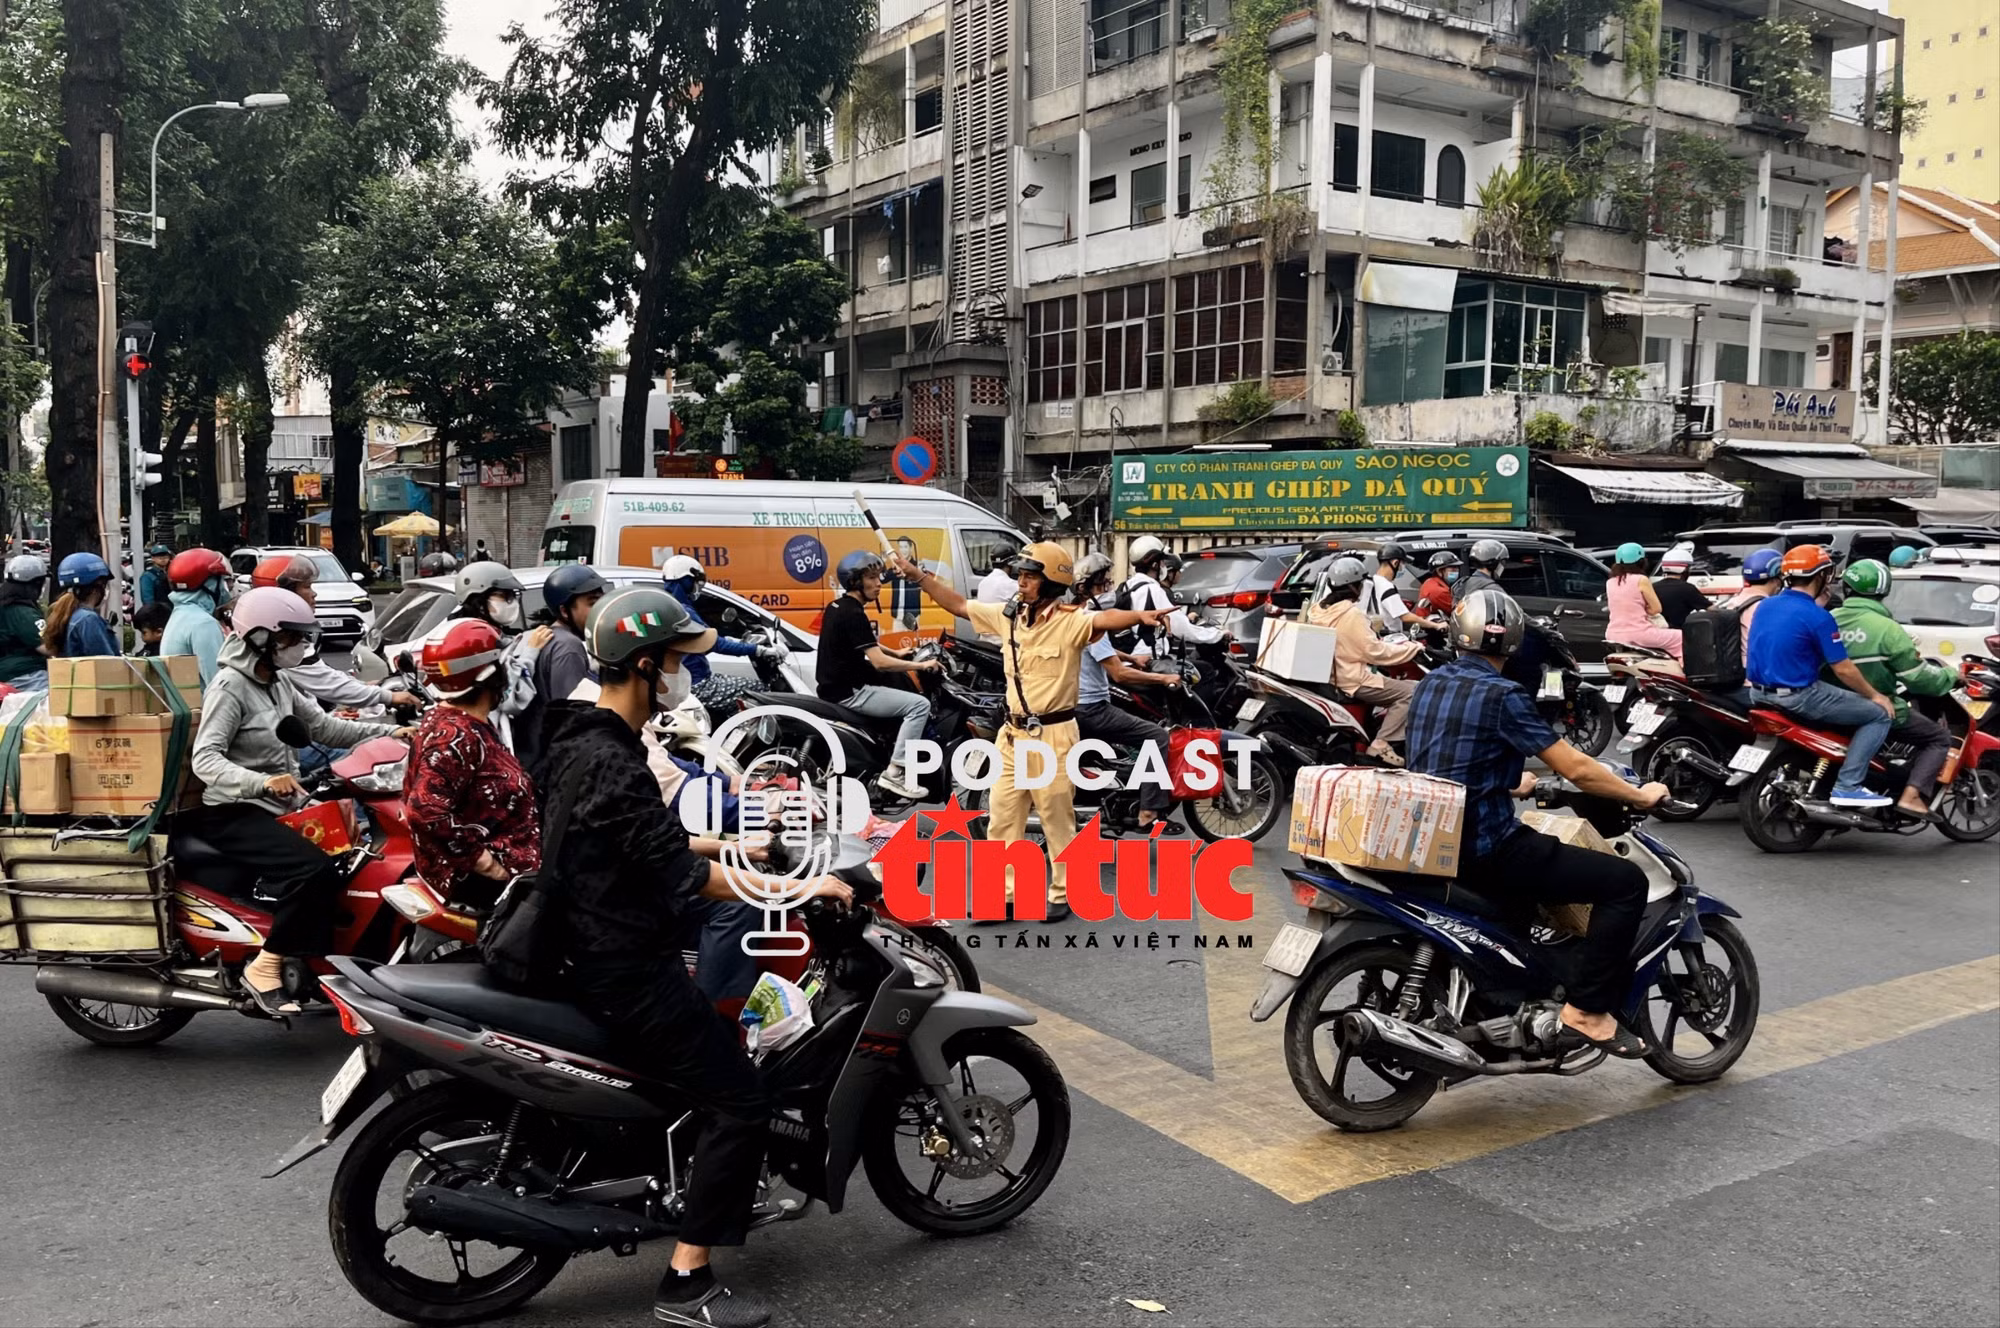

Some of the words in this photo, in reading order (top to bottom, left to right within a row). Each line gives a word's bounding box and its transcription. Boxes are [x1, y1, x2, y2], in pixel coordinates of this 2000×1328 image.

[1804, 394, 1838, 418] Anh
[1753, 419, 1765, 431] May
[1155, 463, 1177, 474] CTY
[1232, 461, 1268, 472] TRANH
[1355, 455, 1397, 469] SAO
[1403, 453, 1471, 471] NGỌC
[1147, 480, 1256, 501] TRANH
[1266, 475, 1352, 499] GHÉP
[1365, 474, 1407, 497] ĐÁ
[1421, 471, 1490, 496] QUÝ
[623, 501, 685, 513] 51B-409.62
[1288, 506, 1316, 514] GEM
[1321, 505, 1346, 513] ART
[753, 512, 771, 526] XE
[773, 513, 816, 526] TRUNG
[1298, 510, 1320, 525] ĐÁ
[1324, 513, 1377, 525] PHONG
[795, 553, 822, 573] 8%
[750, 593, 790, 606] CARD
[769, 1118, 810, 1142] AMAHA
